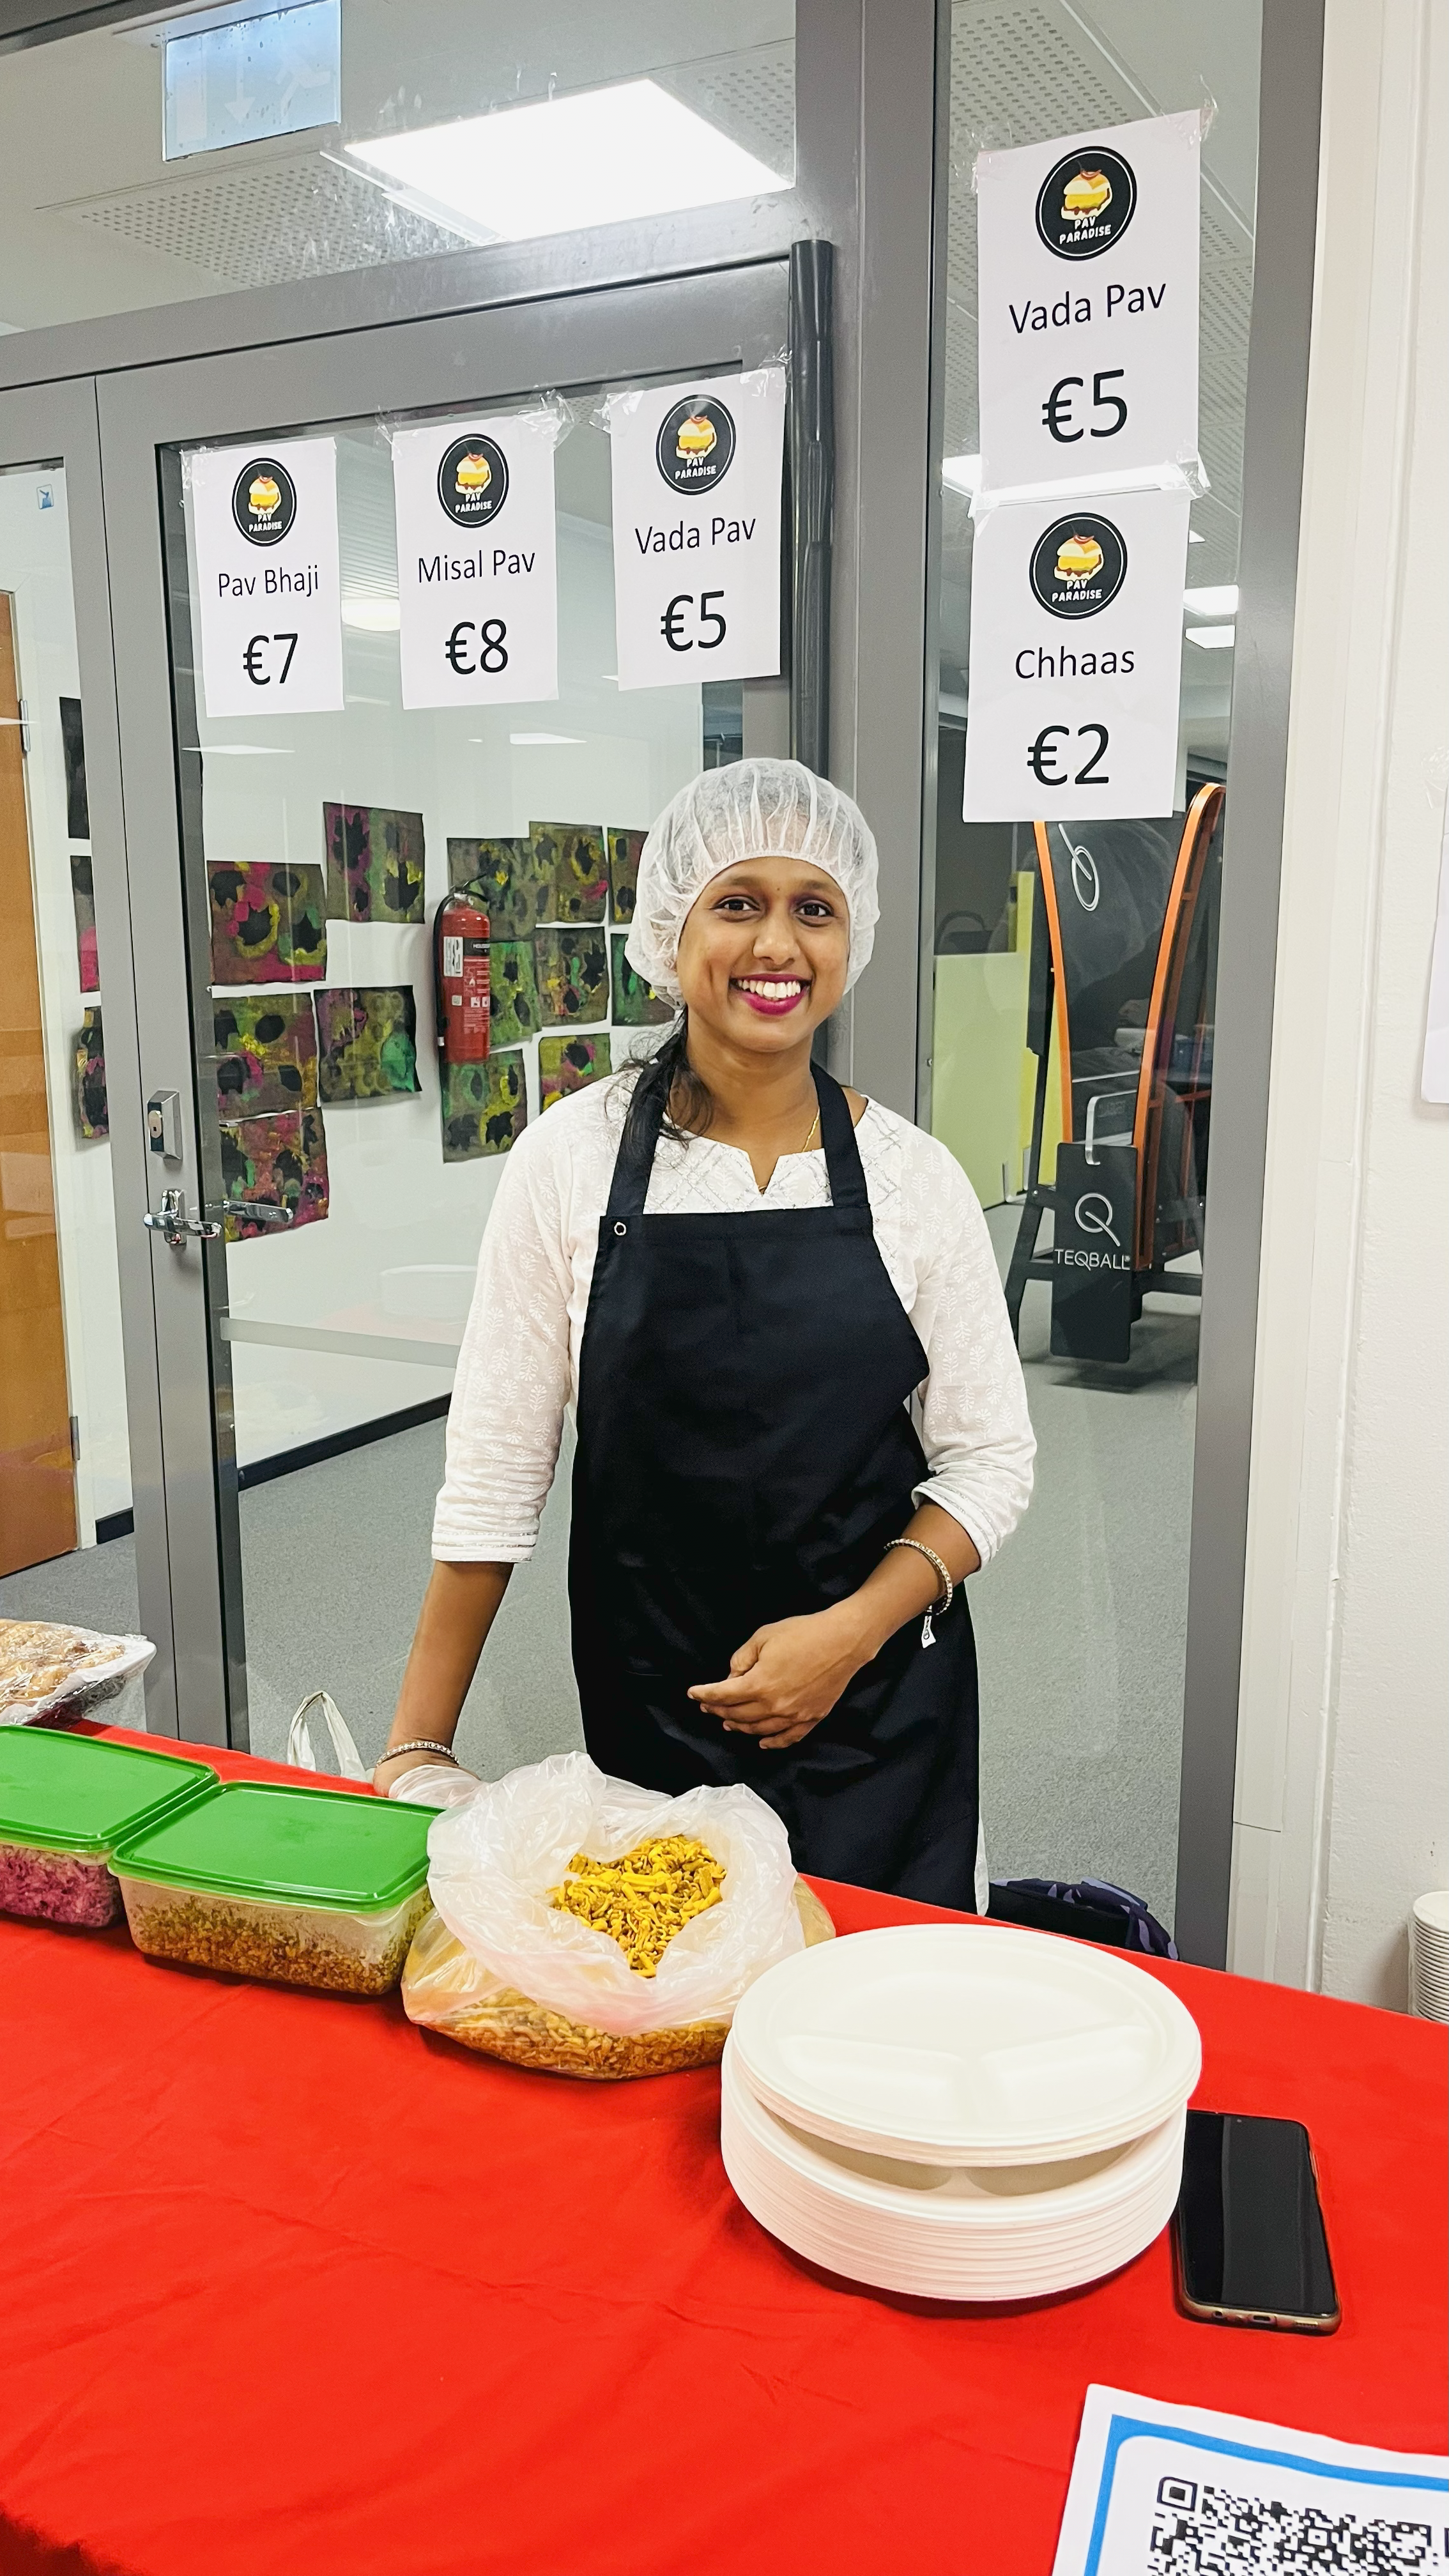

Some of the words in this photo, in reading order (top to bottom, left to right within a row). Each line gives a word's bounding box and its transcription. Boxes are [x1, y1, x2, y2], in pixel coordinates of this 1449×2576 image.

[1059, 224, 1112, 245] PARADISE
[1075, 216, 1096, 229] PAV
[1008, 291, 1091, 334] Vada
[1107, 283, 1166, 318] Pav
[1041, 369, 1128, 443] €5
[675, 465, 717, 480] PARADISE
[686, 456, 704, 468] PAV
[455, 500, 492, 513] PARADISE
[465, 492, 481, 502] PAV
[249, 521, 282, 532] PARADISE
[257, 513, 272, 522] PAV
[634, 520, 700, 555] Vada
[712, 517, 756, 546] Pav
[418, 549, 482, 583] Misal
[493, 549, 535, 576] Pav
[218, 573, 256, 597] Pav
[264, 564, 318, 597] Bhaji
[1066, 579, 1087, 590] PAV
[1052, 588, 1103, 602] PARADISE
[661, 590, 726, 652] €5
[243, 632, 298, 686] €7
[445, 618, 509, 675] €8
[1015, 645, 1135, 679] Chhaas
[1027, 723, 1109, 786] €2
